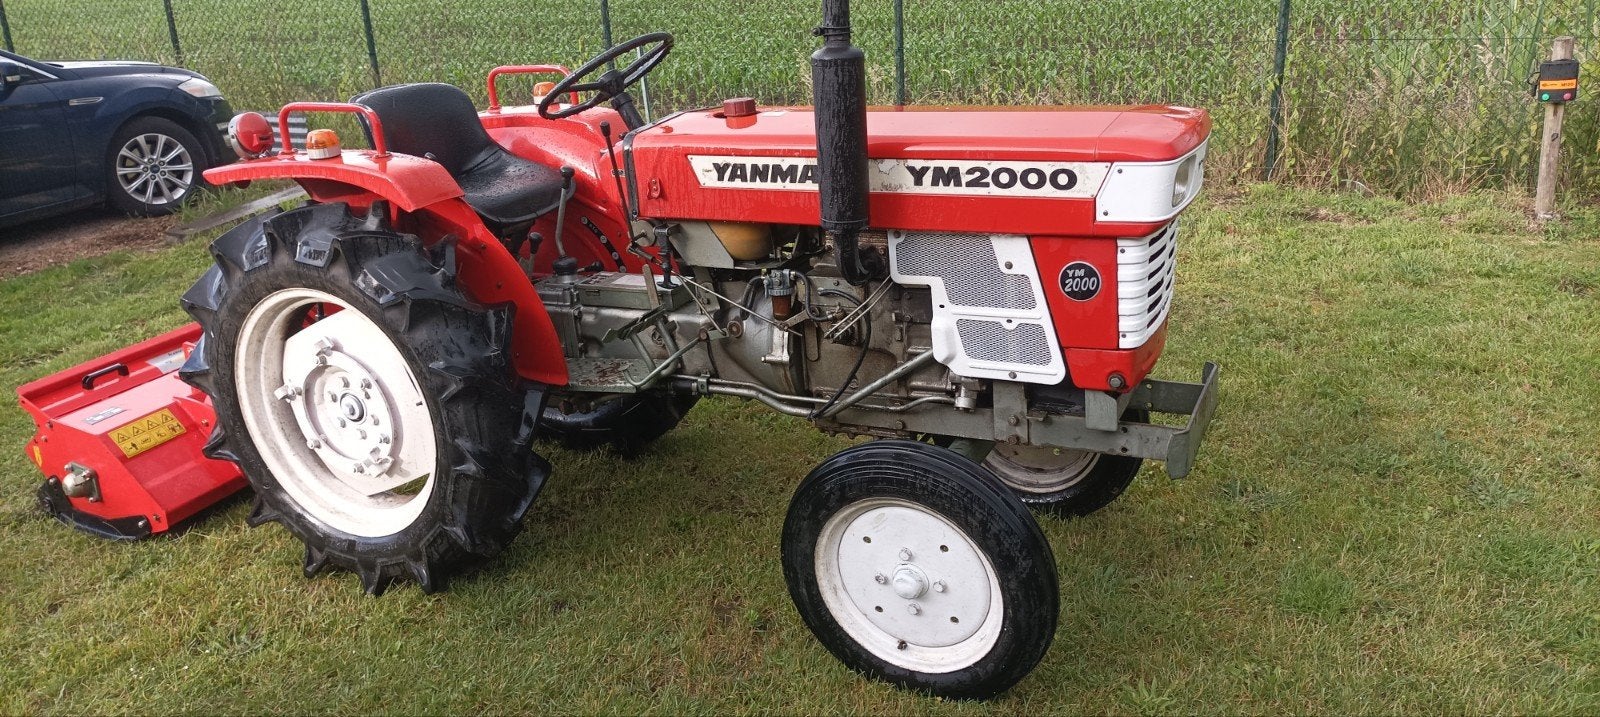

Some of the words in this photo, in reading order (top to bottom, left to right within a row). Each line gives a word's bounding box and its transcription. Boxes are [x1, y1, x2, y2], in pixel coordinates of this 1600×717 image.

[712, 162, 819, 184] YANMA
[905, 165, 1078, 191] YM2000
[1066, 268, 1085, 277] YM
[1064, 277, 1098, 292] 2000
